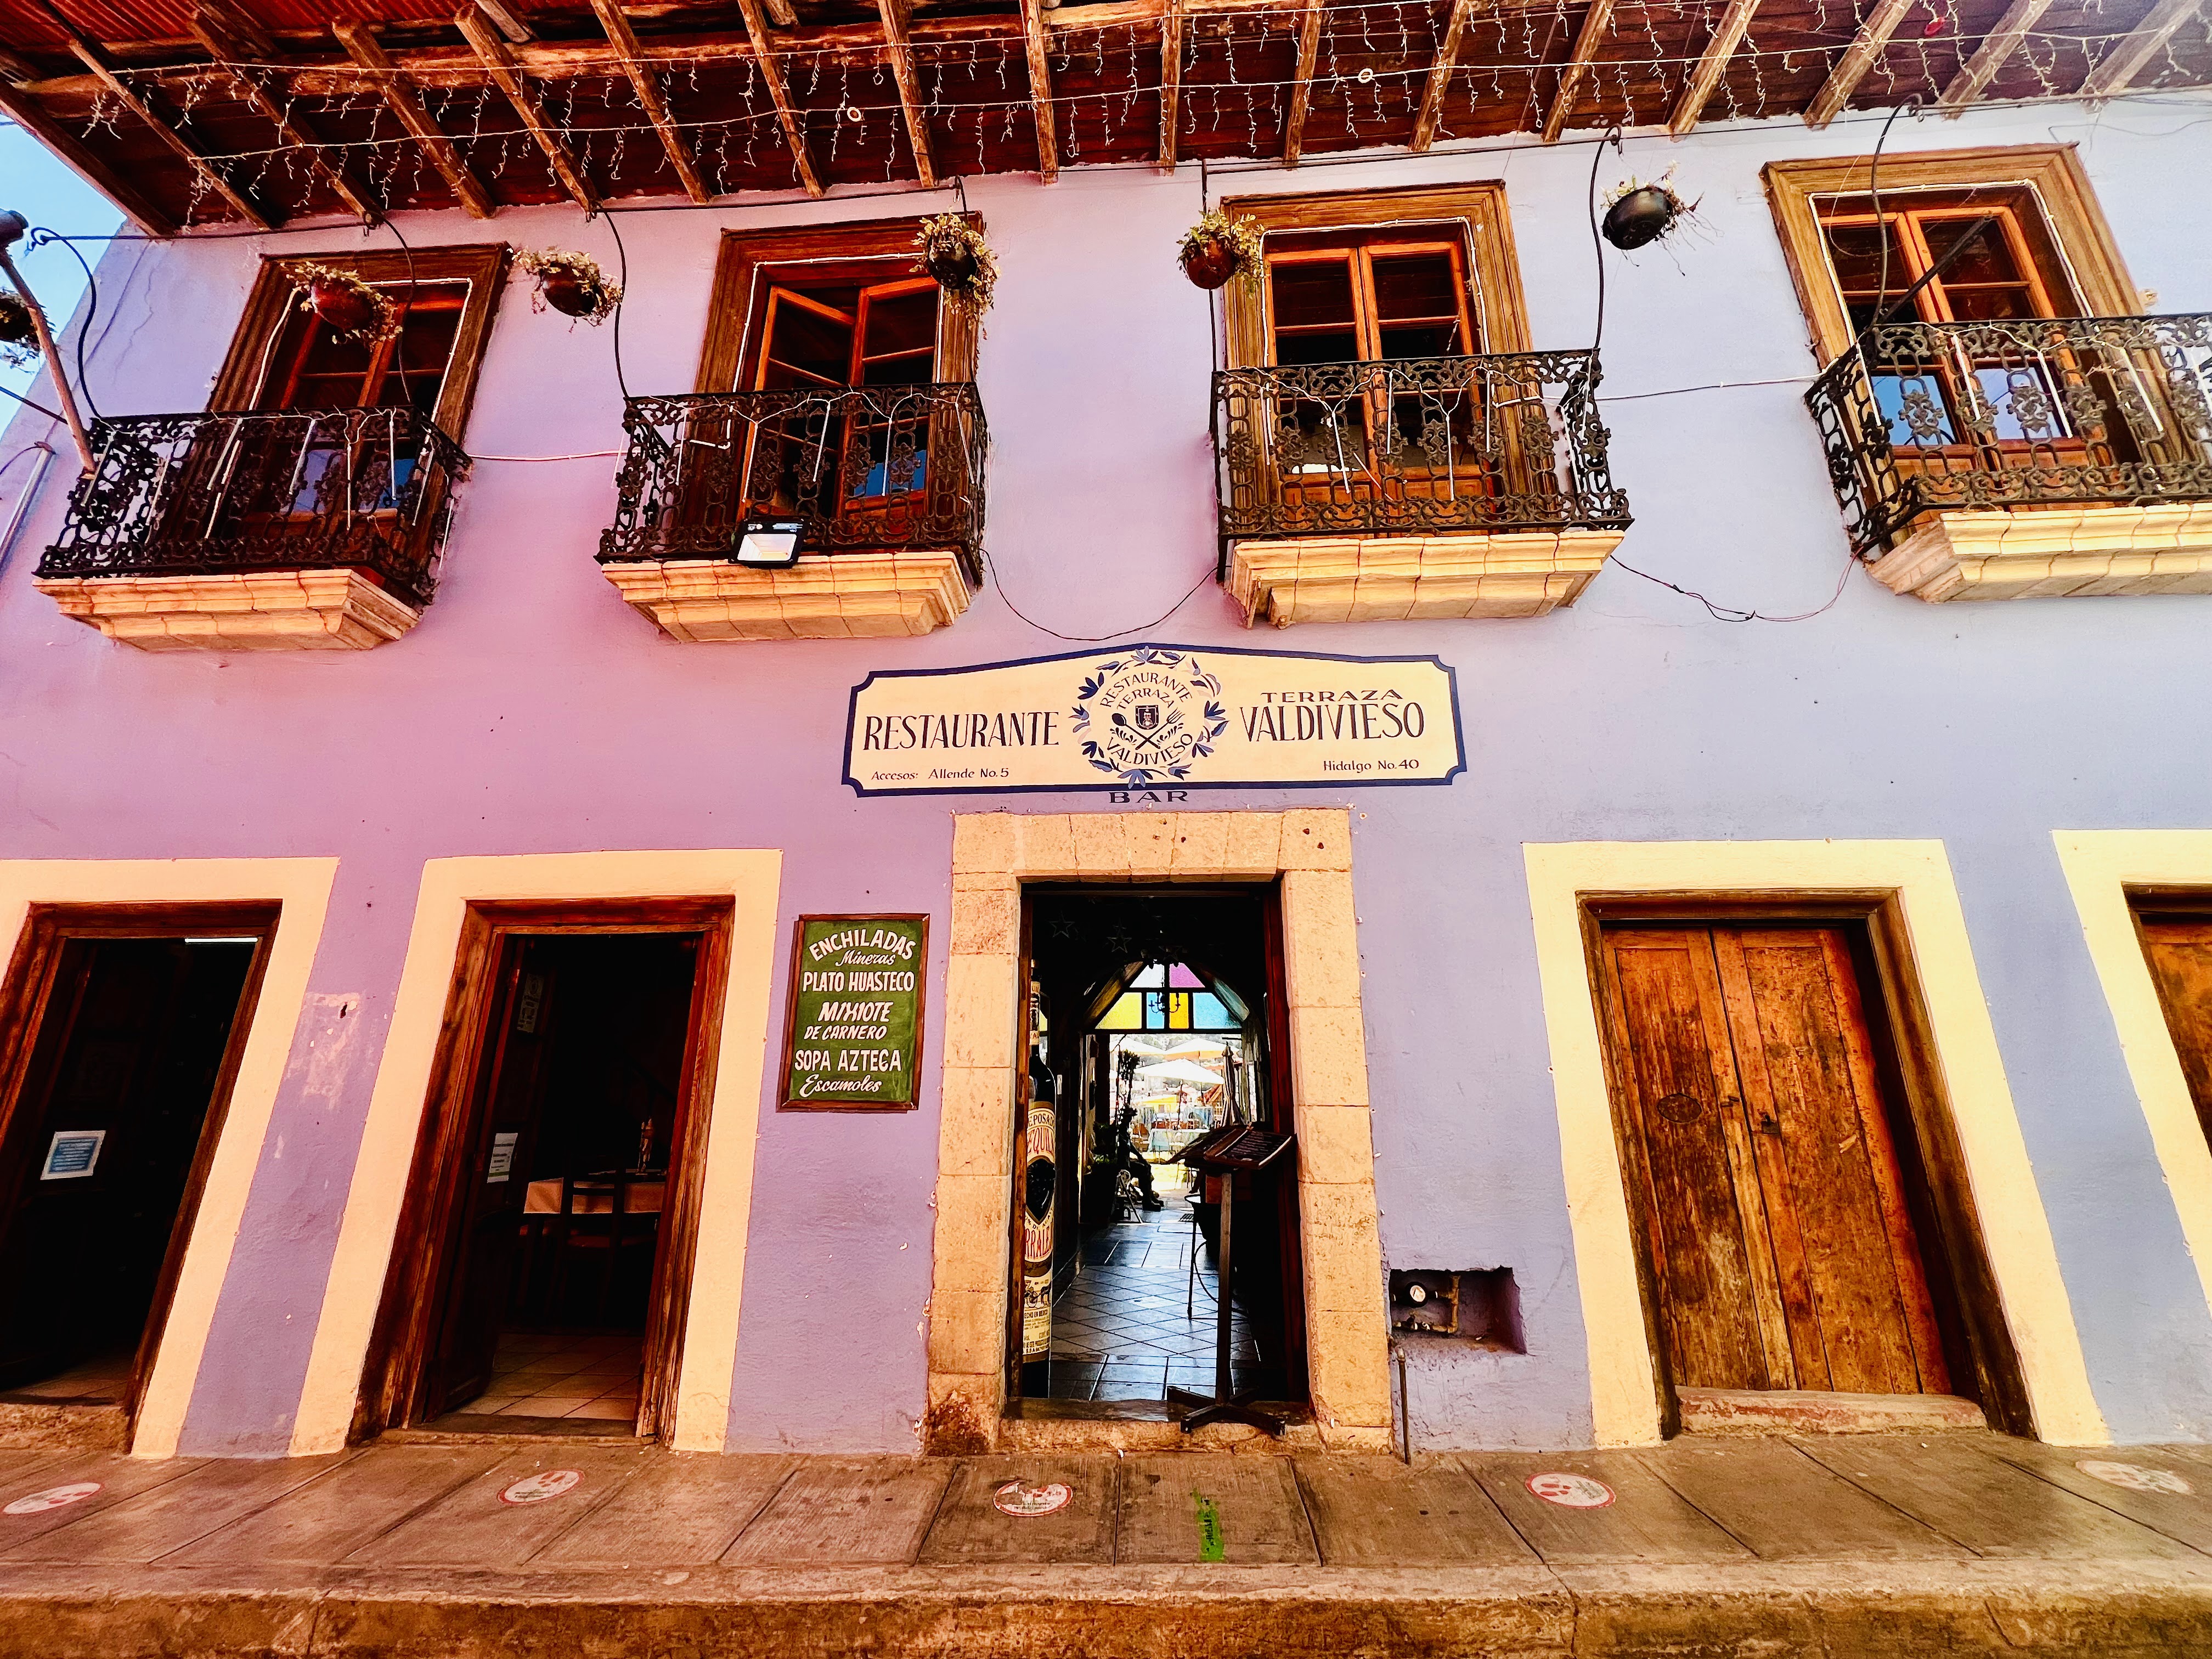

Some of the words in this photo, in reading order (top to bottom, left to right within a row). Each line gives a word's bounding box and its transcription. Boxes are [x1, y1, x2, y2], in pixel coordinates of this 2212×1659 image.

[1099, 673, 1193, 708] RESTAURANTE
[1116, 688, 1175, 710] TERRAZA
[1260, 689, 1403, 703] TERRAZA
[862, 712, 1059, 751] RESTAURANTE
[1239, 702, 1424, 742] VALDIVIESO
[1107, 733, 1193, 765] VALDIVIESO
[871, 771, 918, 780] Accesos:
[928, 768, 975, 779] Allende
[1323, 760, 1372, 774] Hidalgo
[1109, 791, 1189, 804] BAR
[809, 928, 917, 962] ENCHILADAS
[835, 949, 896, 967] Mineras
[802, 971, 845, 992] PLATO
[848, 971, 915, 992] HUASTECO
[817, 1001, 894, 1022] MIXIOTE
[803, 1025, 821, 1040] DE
[821, 1025, 888, 1041] CARNERO
[794, 1049, 831, 1071] SOPA
[837, 1048, 902, 1072] AZTECA
[799, 1074, 883, 1098] Escamoles
[1028, 1113, 1055, 1128] EPOSAD
